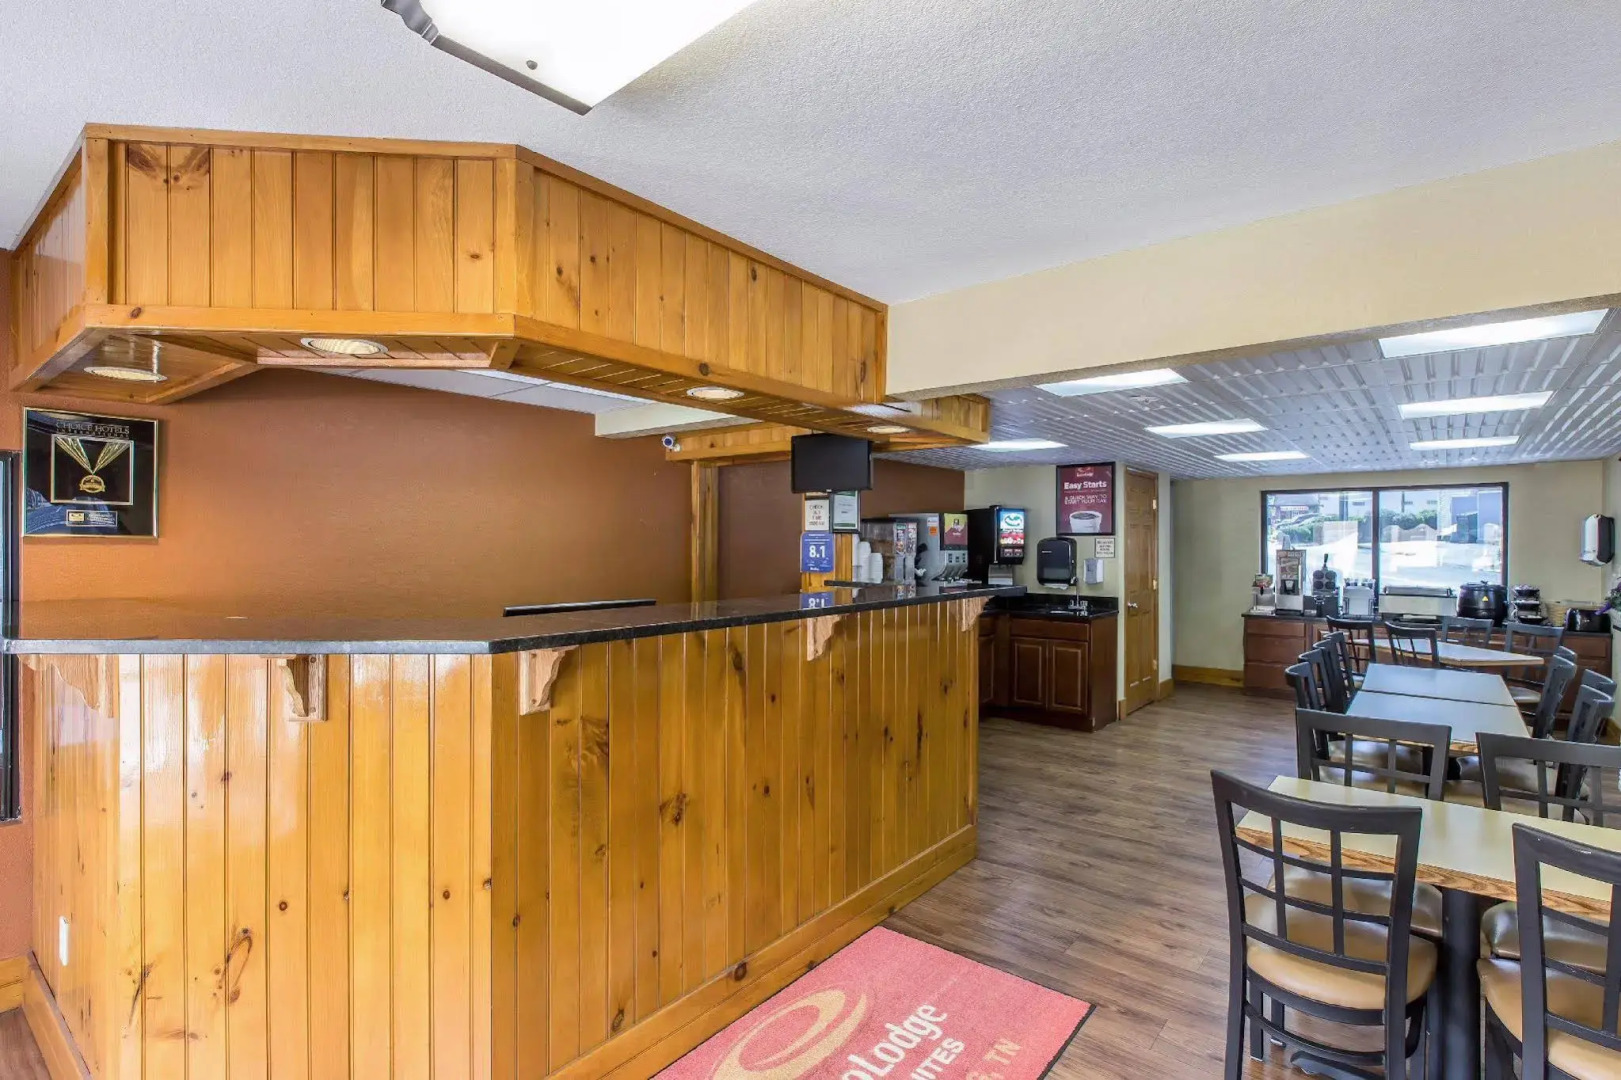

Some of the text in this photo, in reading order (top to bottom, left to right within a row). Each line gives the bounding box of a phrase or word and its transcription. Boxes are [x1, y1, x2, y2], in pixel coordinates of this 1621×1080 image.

[56, 422, 129, 435] CHOICE HOTELS
[1064, 482, 1082, 490] Easy
[809, 545, 826, 558] 8.1
[983, 1038, 1022, 1065] TN
